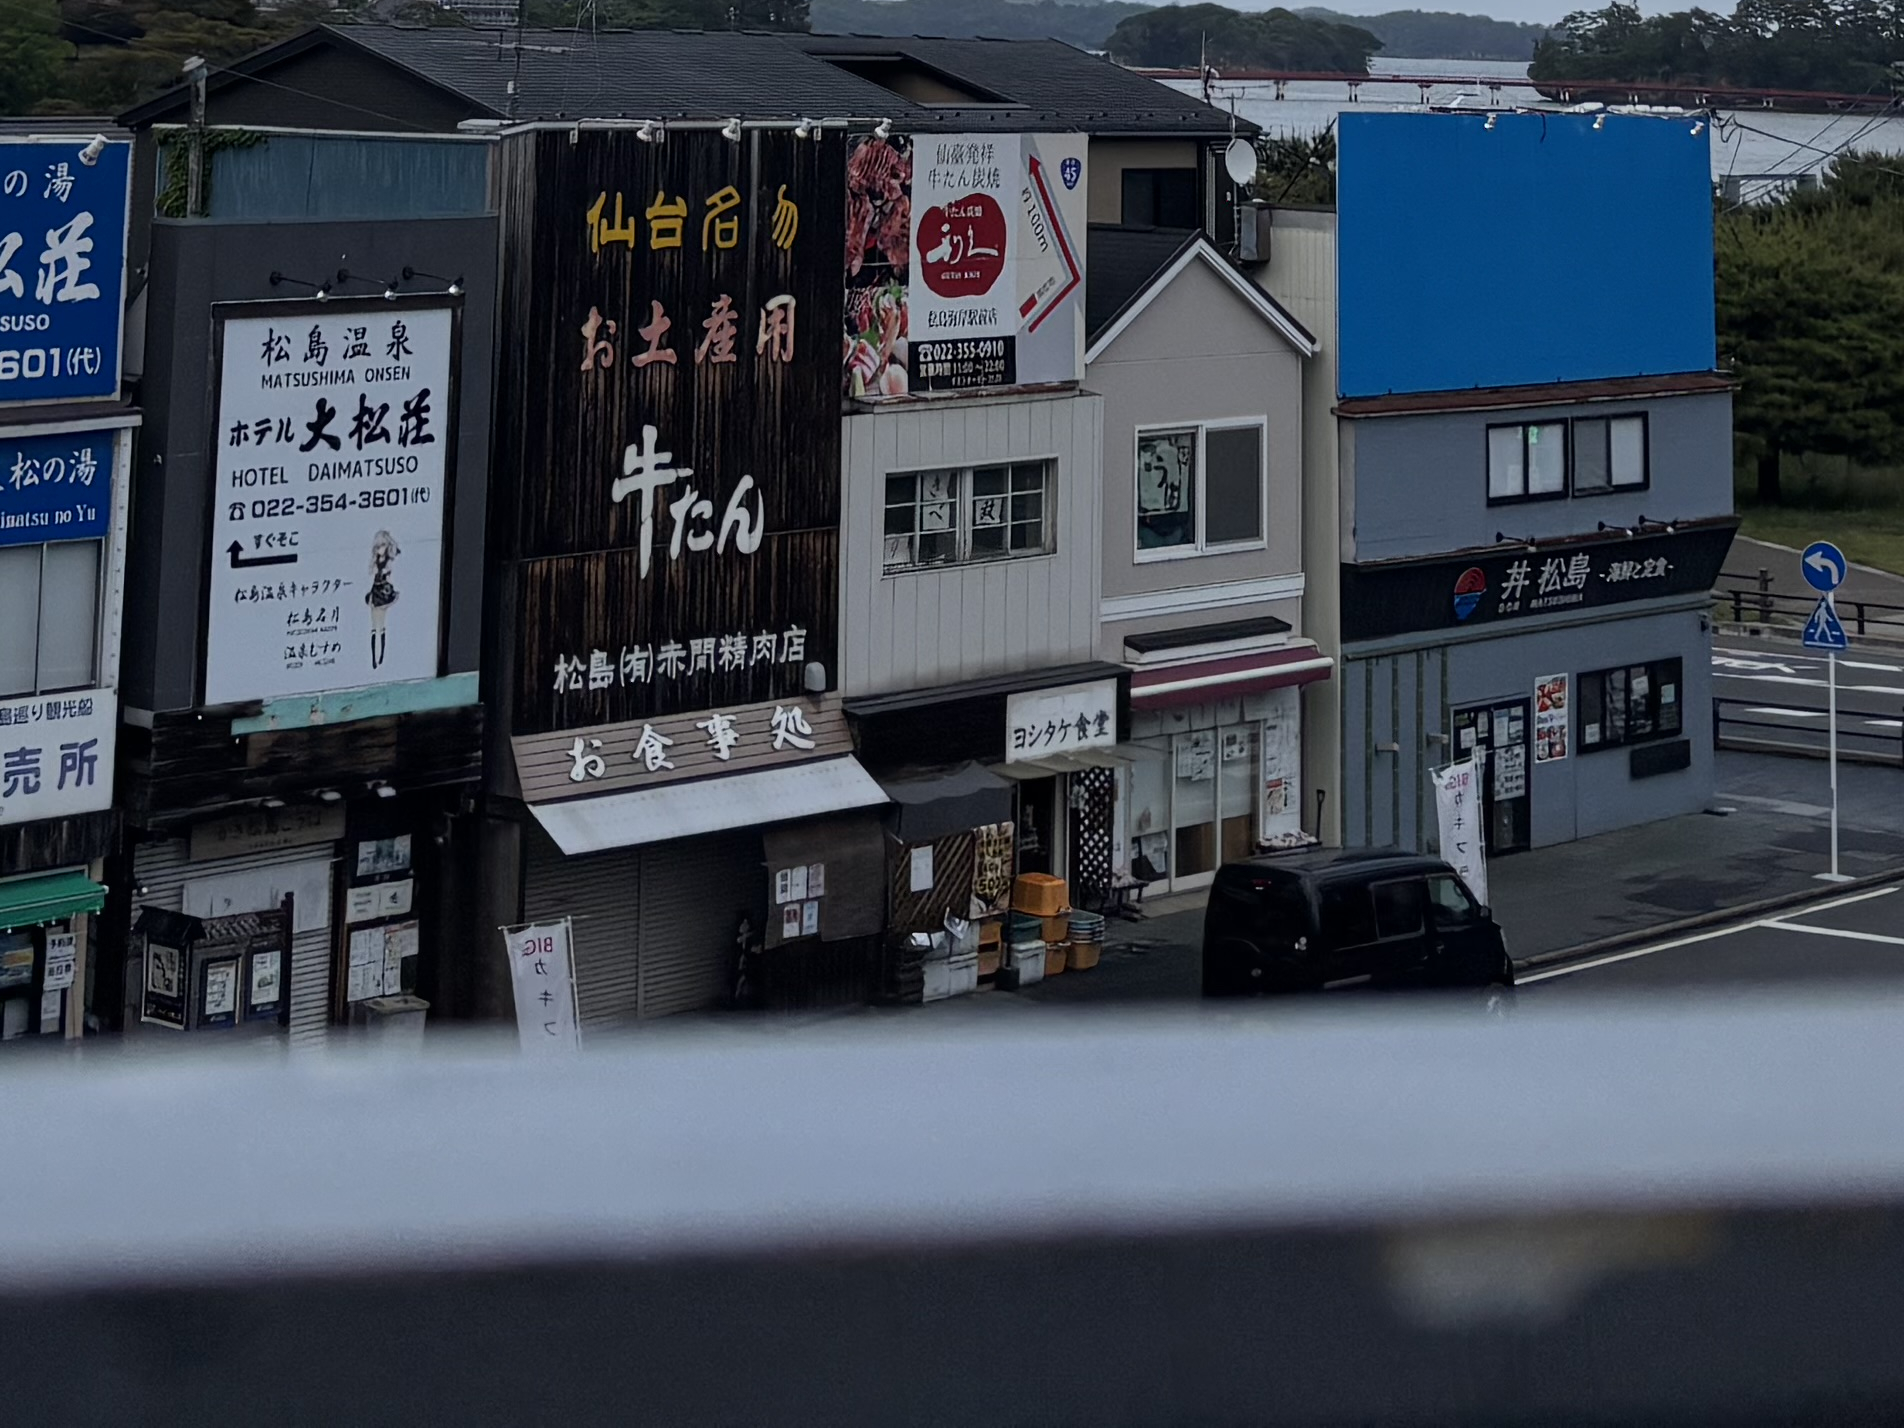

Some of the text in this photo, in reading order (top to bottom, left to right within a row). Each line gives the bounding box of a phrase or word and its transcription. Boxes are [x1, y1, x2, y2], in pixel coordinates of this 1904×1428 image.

[261, 320, 414, 367] 松島温泉
[580, 294, 797, 372] お土産用
[261, 365, 411, 389] MATSUSHIMA ONSEN
[232, 455, 419, 488] HOTEL DAIMATSUSO
[54, 510, 73, 525] no
[76, 503, 96, 524] Yu
[612, 424, 765, 580] 牛たん
[253, 531, 299, 550] すぐそこ
[1538, 552, 1591, 595] 松島
[566, 705, 816, 783] お食事処
[1014, 709, 1109, 749] ヨシタケ食堂
